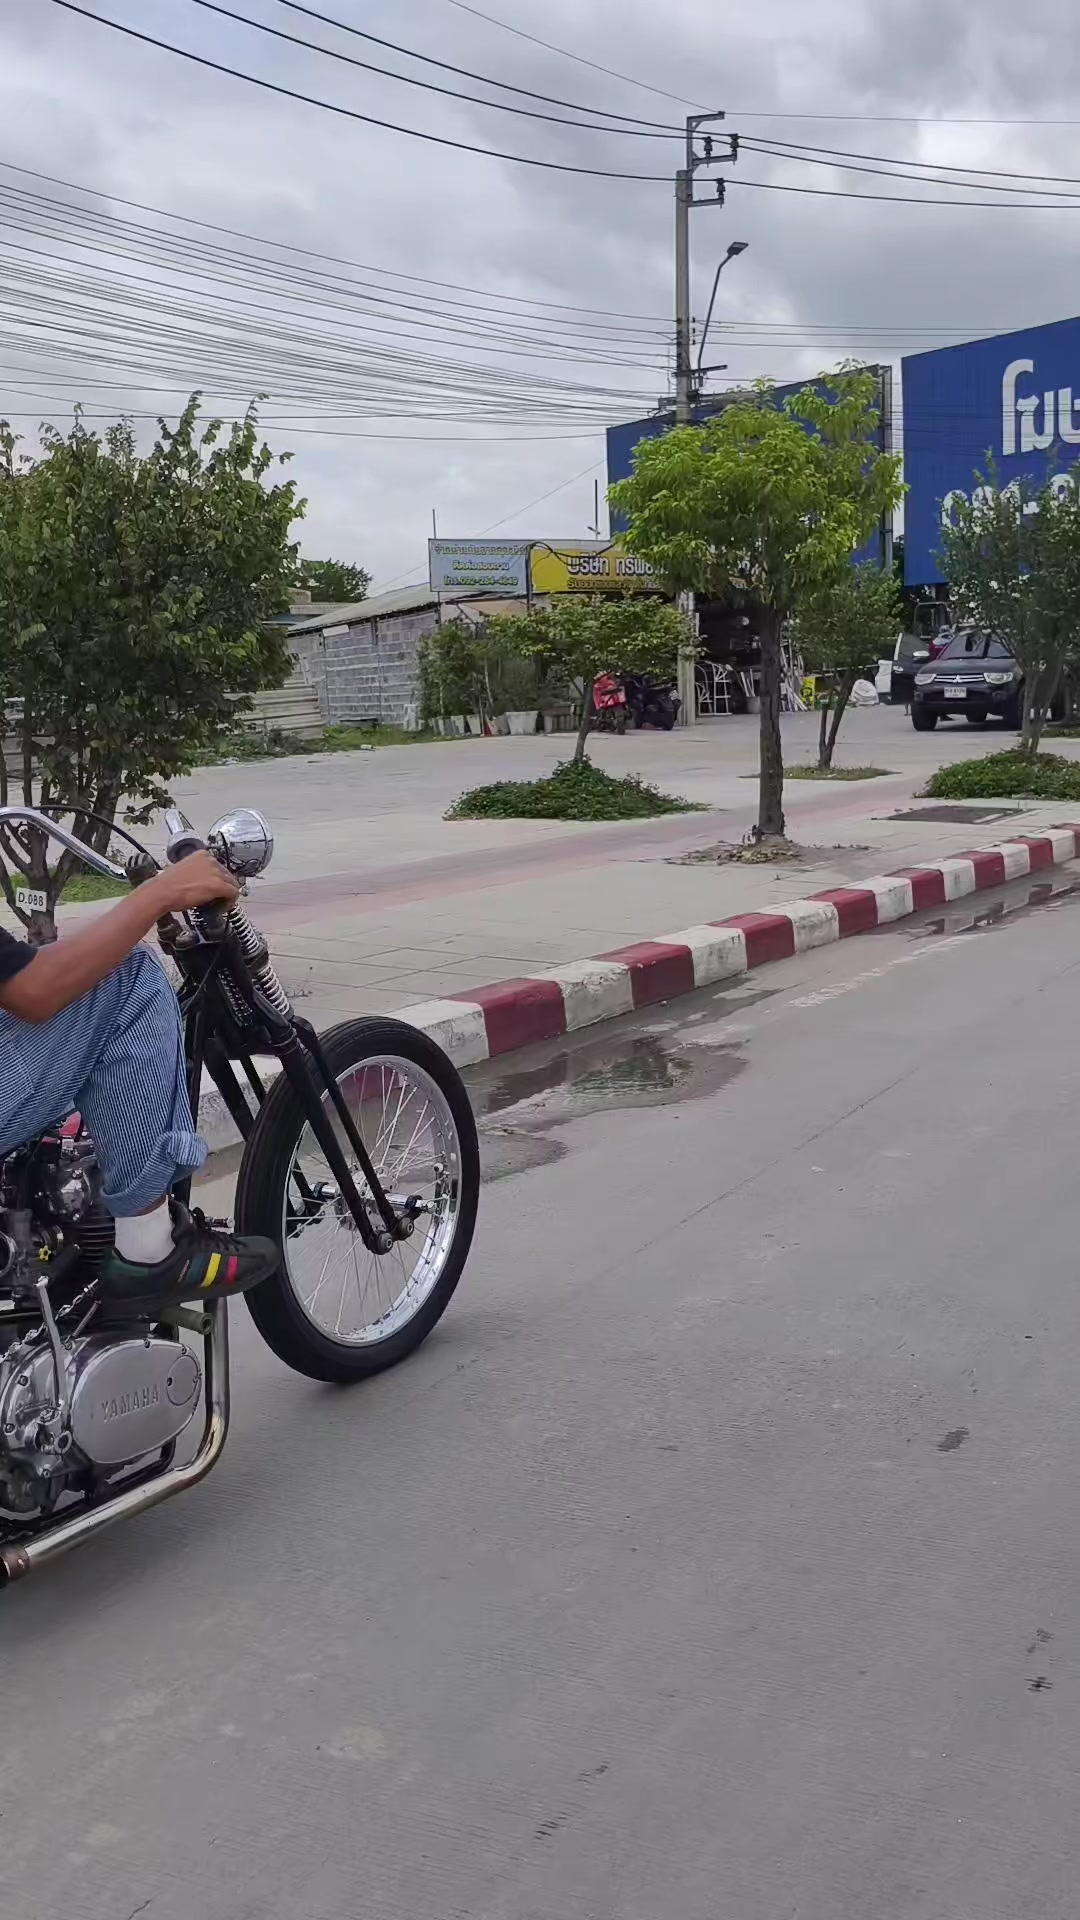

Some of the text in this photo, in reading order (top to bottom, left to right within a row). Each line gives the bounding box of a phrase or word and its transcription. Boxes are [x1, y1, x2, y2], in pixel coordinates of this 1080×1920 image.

[567, 551, 610, 574] บริษัท
[18, 892, 44, 907] D.088
[101, 1384, 160, 1423] YAMAHA
